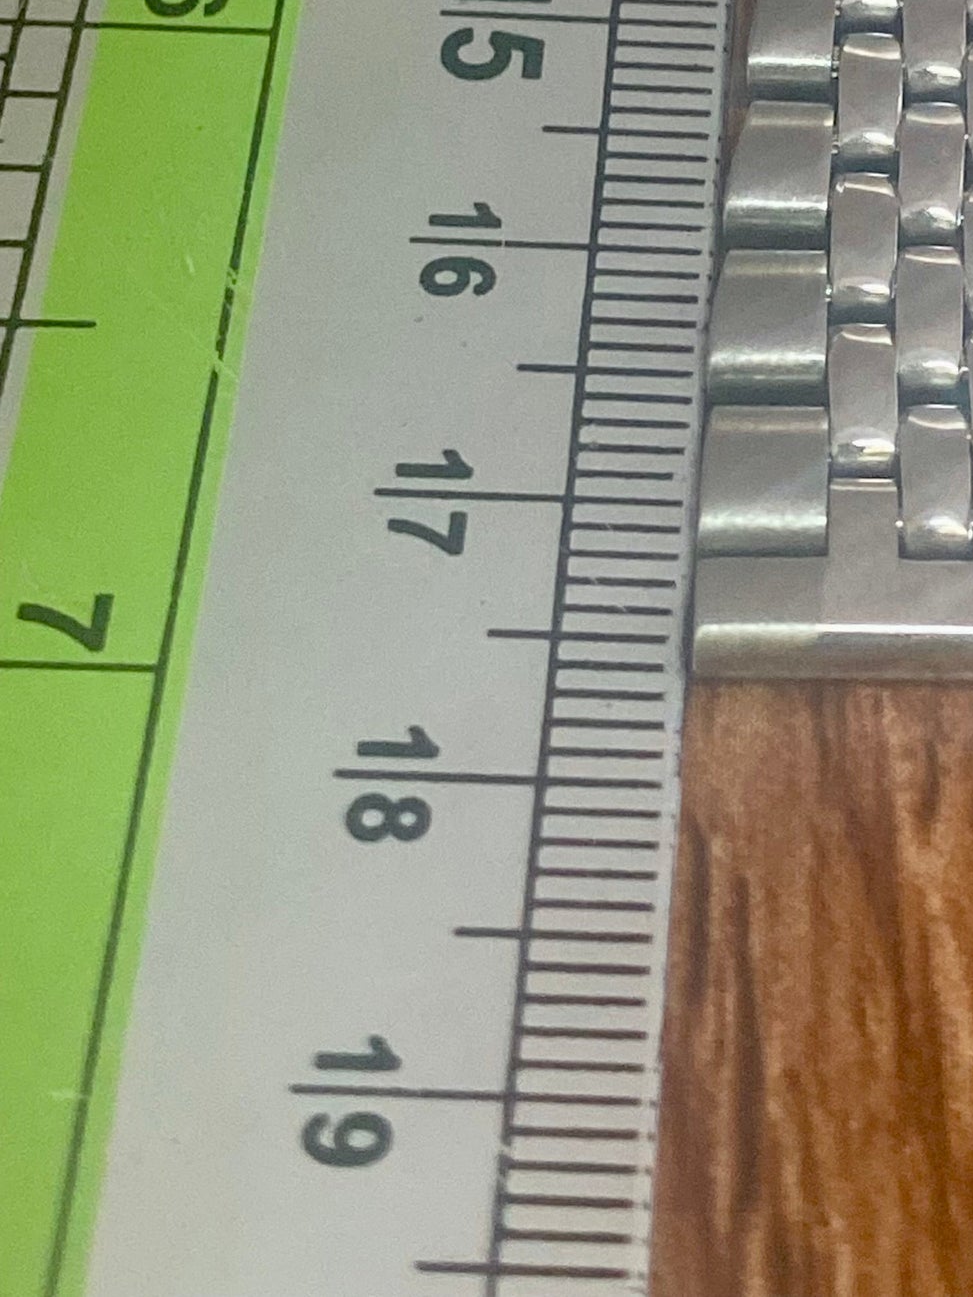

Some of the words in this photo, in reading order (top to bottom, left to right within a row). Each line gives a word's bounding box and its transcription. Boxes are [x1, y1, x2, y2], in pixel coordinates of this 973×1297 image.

[418, 202, 503, 297] 16
[387, 449, 475, 556] 17
[15, 593, 115, 653] 7
[344, 725, 440, 843] 18
[301, 1034, 401, 1168] 19
